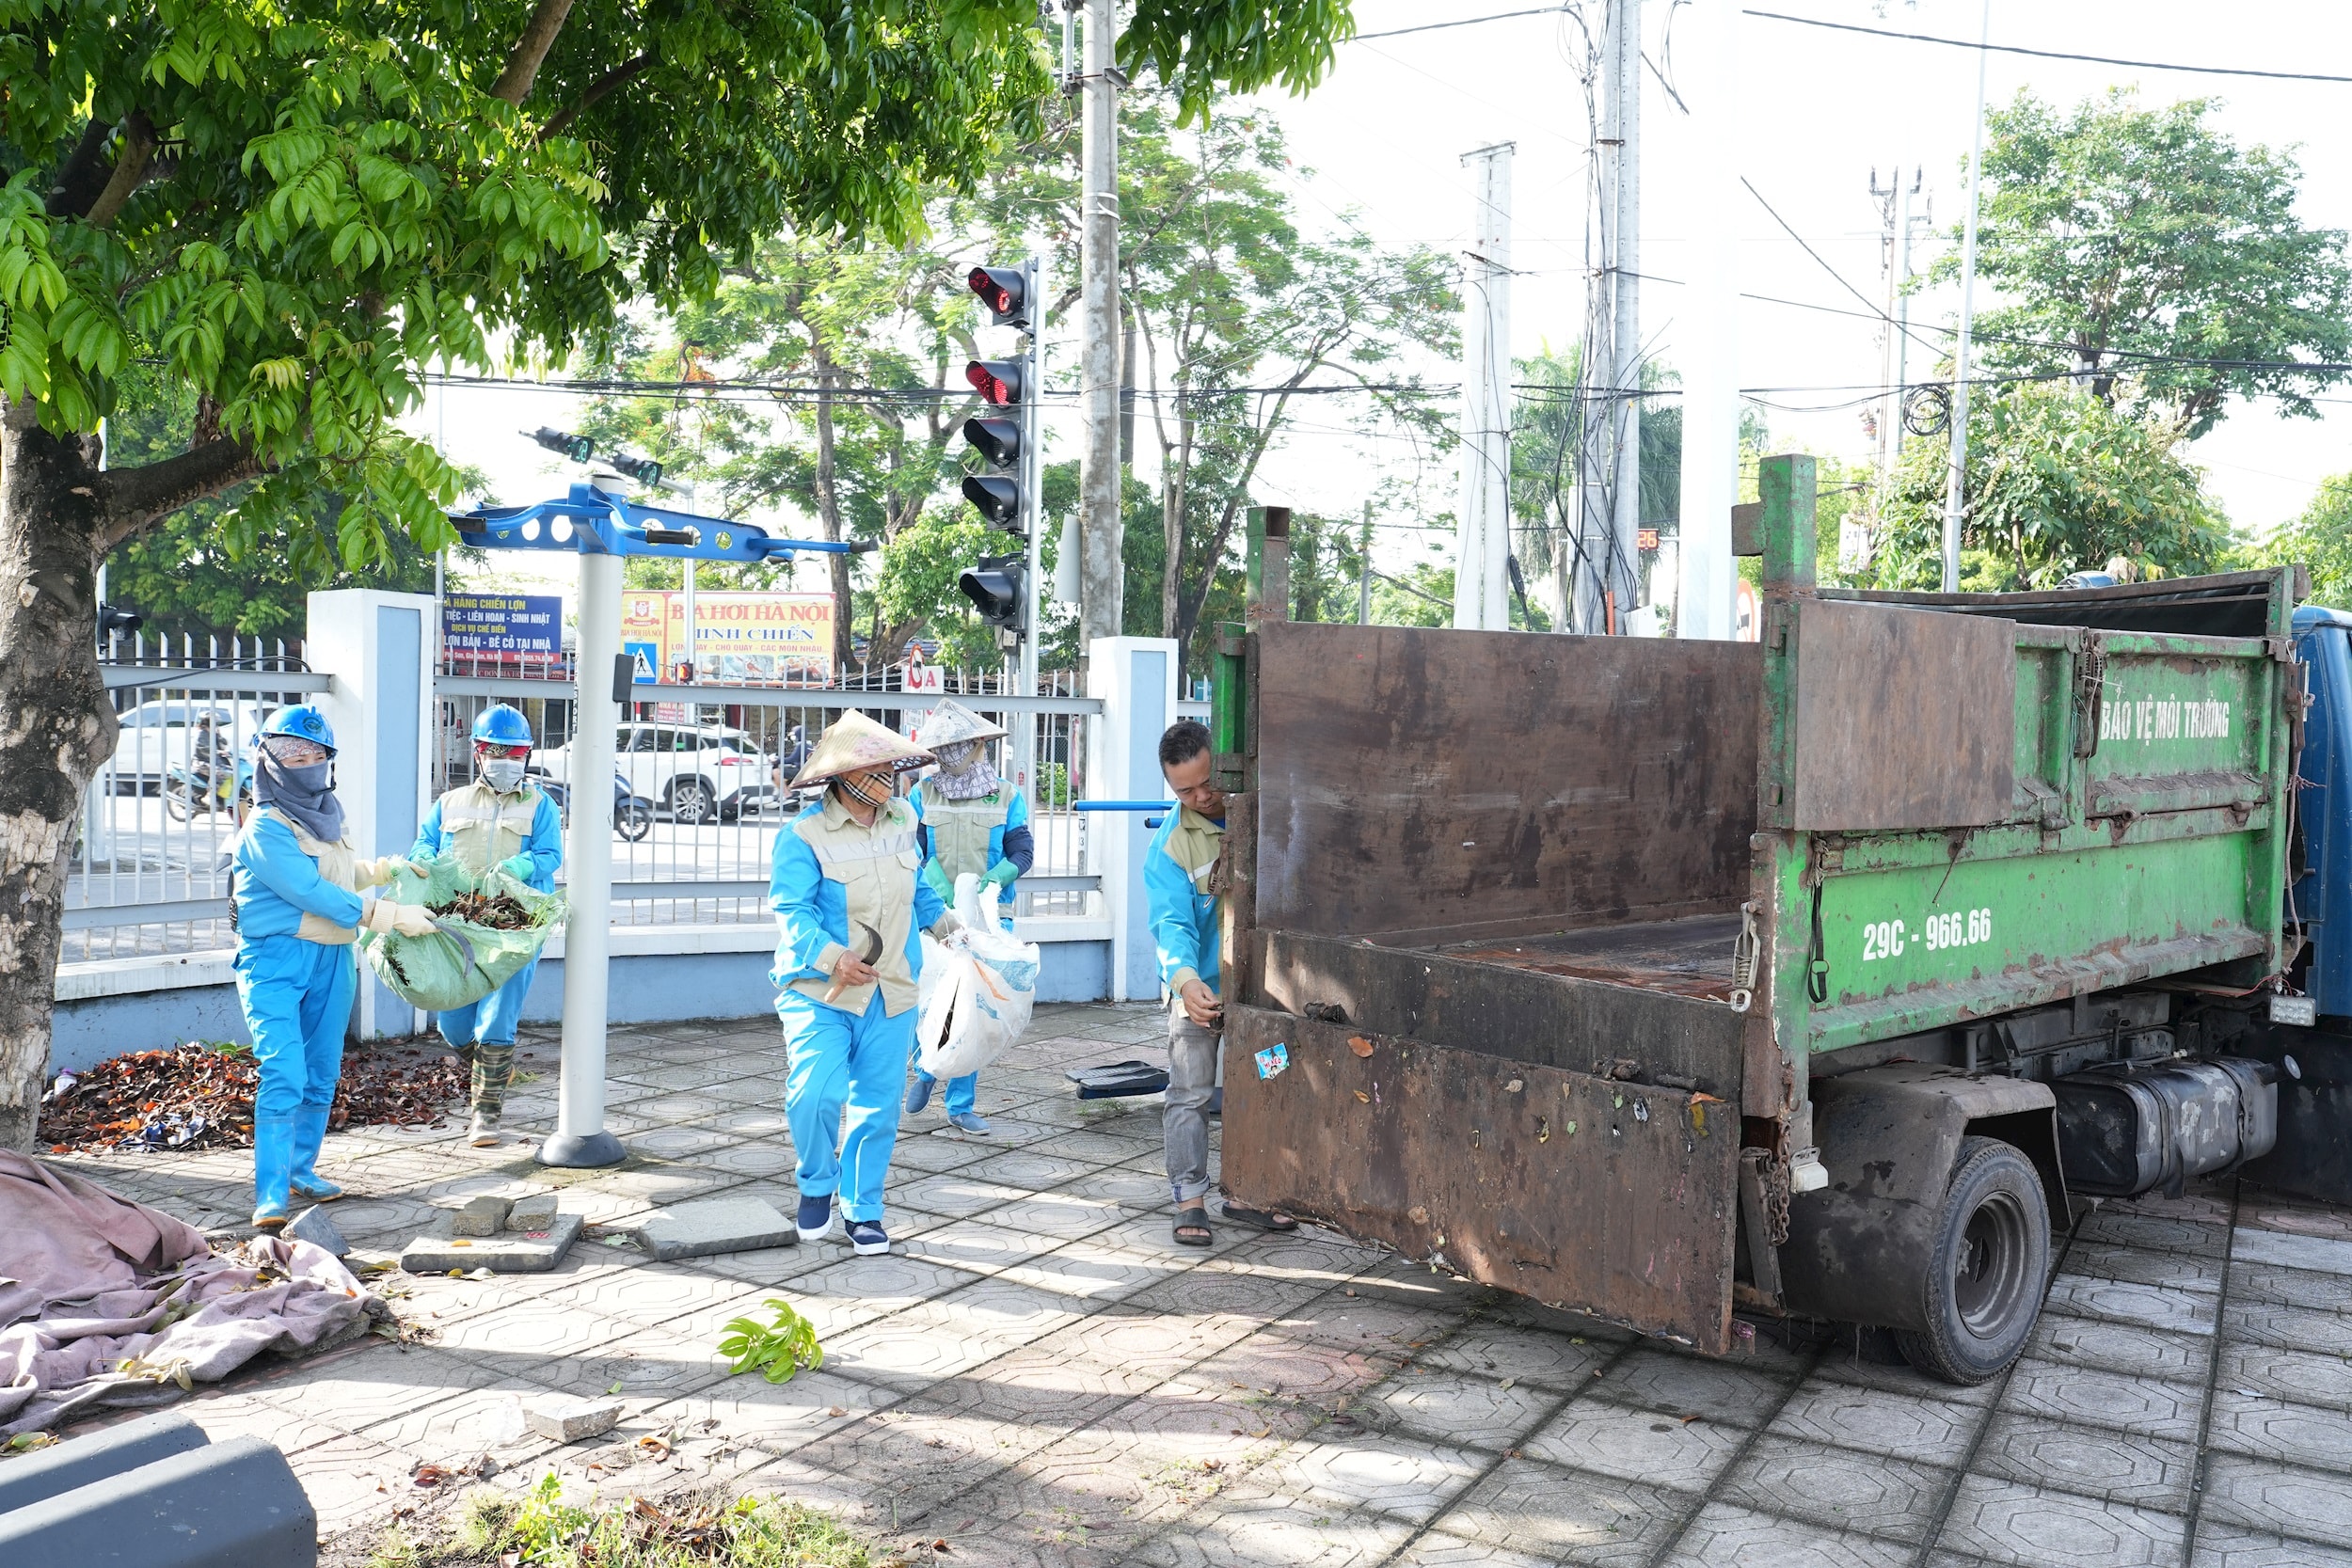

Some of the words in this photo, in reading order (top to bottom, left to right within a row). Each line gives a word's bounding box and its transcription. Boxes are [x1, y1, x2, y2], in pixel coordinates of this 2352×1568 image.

[1638, 531, 1658, 547] 26
[453, 596, 477, 609] HÀNG
[480, 596, 506, 610] CHIẾN
[509, 600, 526, 612] LỢN
[445, 610, 461, 622] TIỆC
[468, 610, 484, 622] LIÊN
[485, 612, 505, 623] HOAN
[512, 613, 529, 624] SINH
[531, 612, 550, 626] NHẬT
[671, 604, 706, 620] BA
[710, 604, 749, 621] HƠI
[755, 601, 787, 621] HÀ
[789, 602, 830, 626] NỘI
[695, 627, 740, 640] INH
[748, 624, 815, 641] CHIẾN
[489, 635, 501, 648] BÊ
[532, 637, 551, 650] NHÀ
[2101, 687, 2132, 740] BẢO
[2136, 693, 2153, 746] VỆ
[2155, 693, 2181, 739] MÔI
[1863, 919, 1905, 961] 29C
[1926, 908, 1992, 951] 966.66
